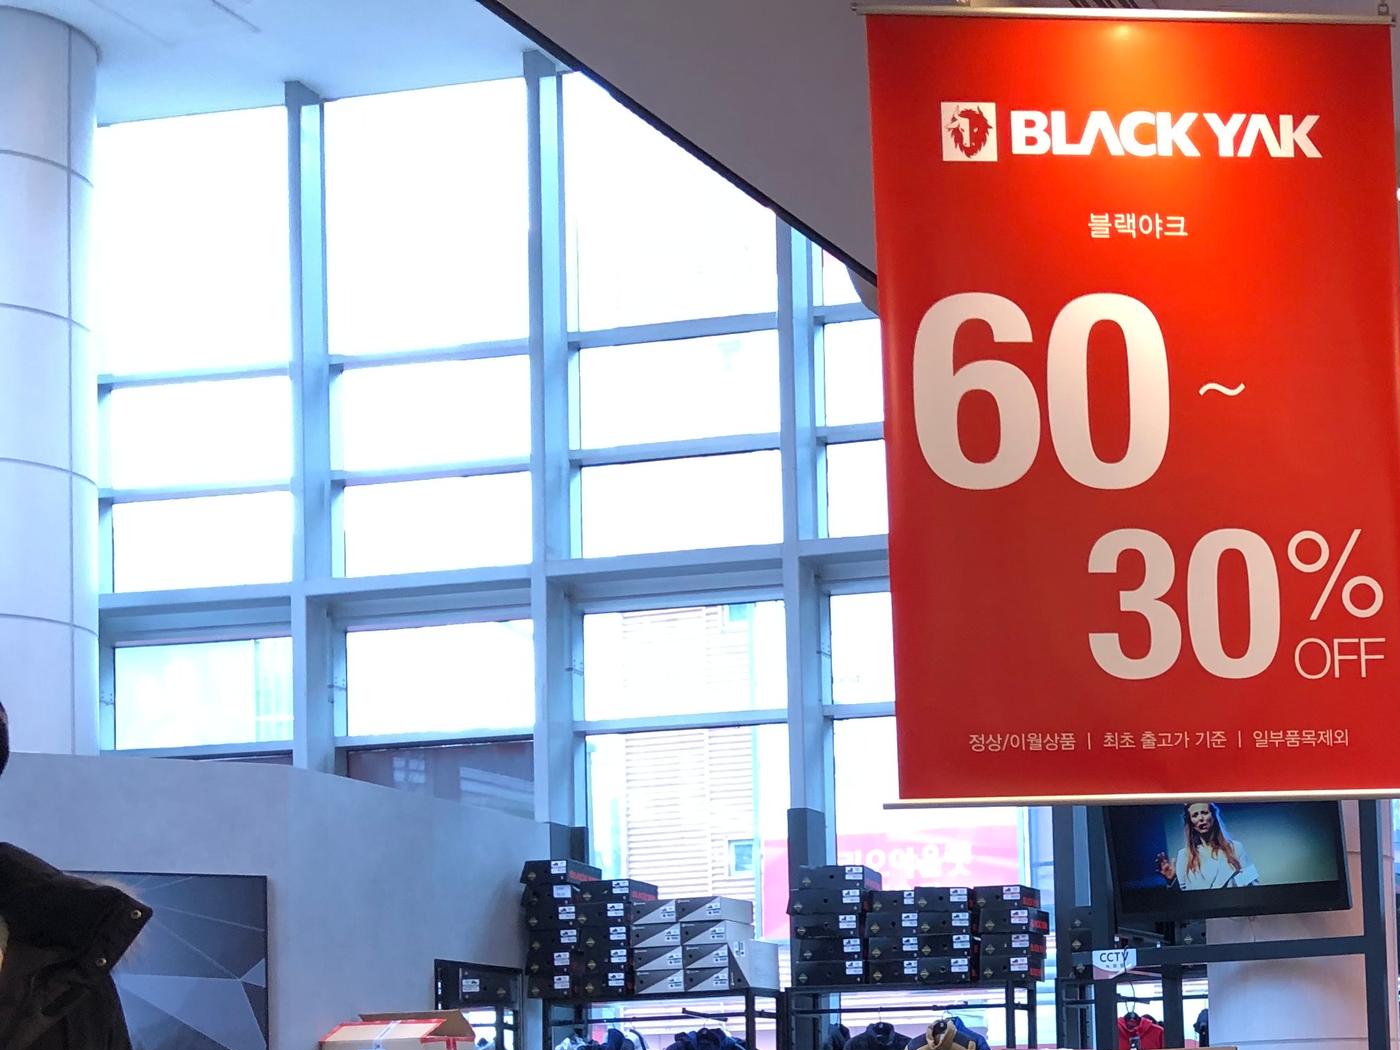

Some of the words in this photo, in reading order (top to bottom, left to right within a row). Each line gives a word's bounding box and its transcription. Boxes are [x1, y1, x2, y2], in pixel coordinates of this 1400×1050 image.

[1010, 110, 1201, 156] BLACK
[1202, 112, 1323, 159] YAK
[1088, 212, 1189, 239] 블랙야크
[912, 291, 1170, 491] 60
[1294, 637, 1386, 679] OFF
[968, 732, 1076, 753] 정상/이월상품
[1103, 731, 1135, 750] 최초
[1139, 730, 1190, 750] 출고가
[1195, 729, 1227, 749] 기준
[1252, 728, 1349, 749] 일부품목제외
[1099, 951, 1129, 963] CCTV
